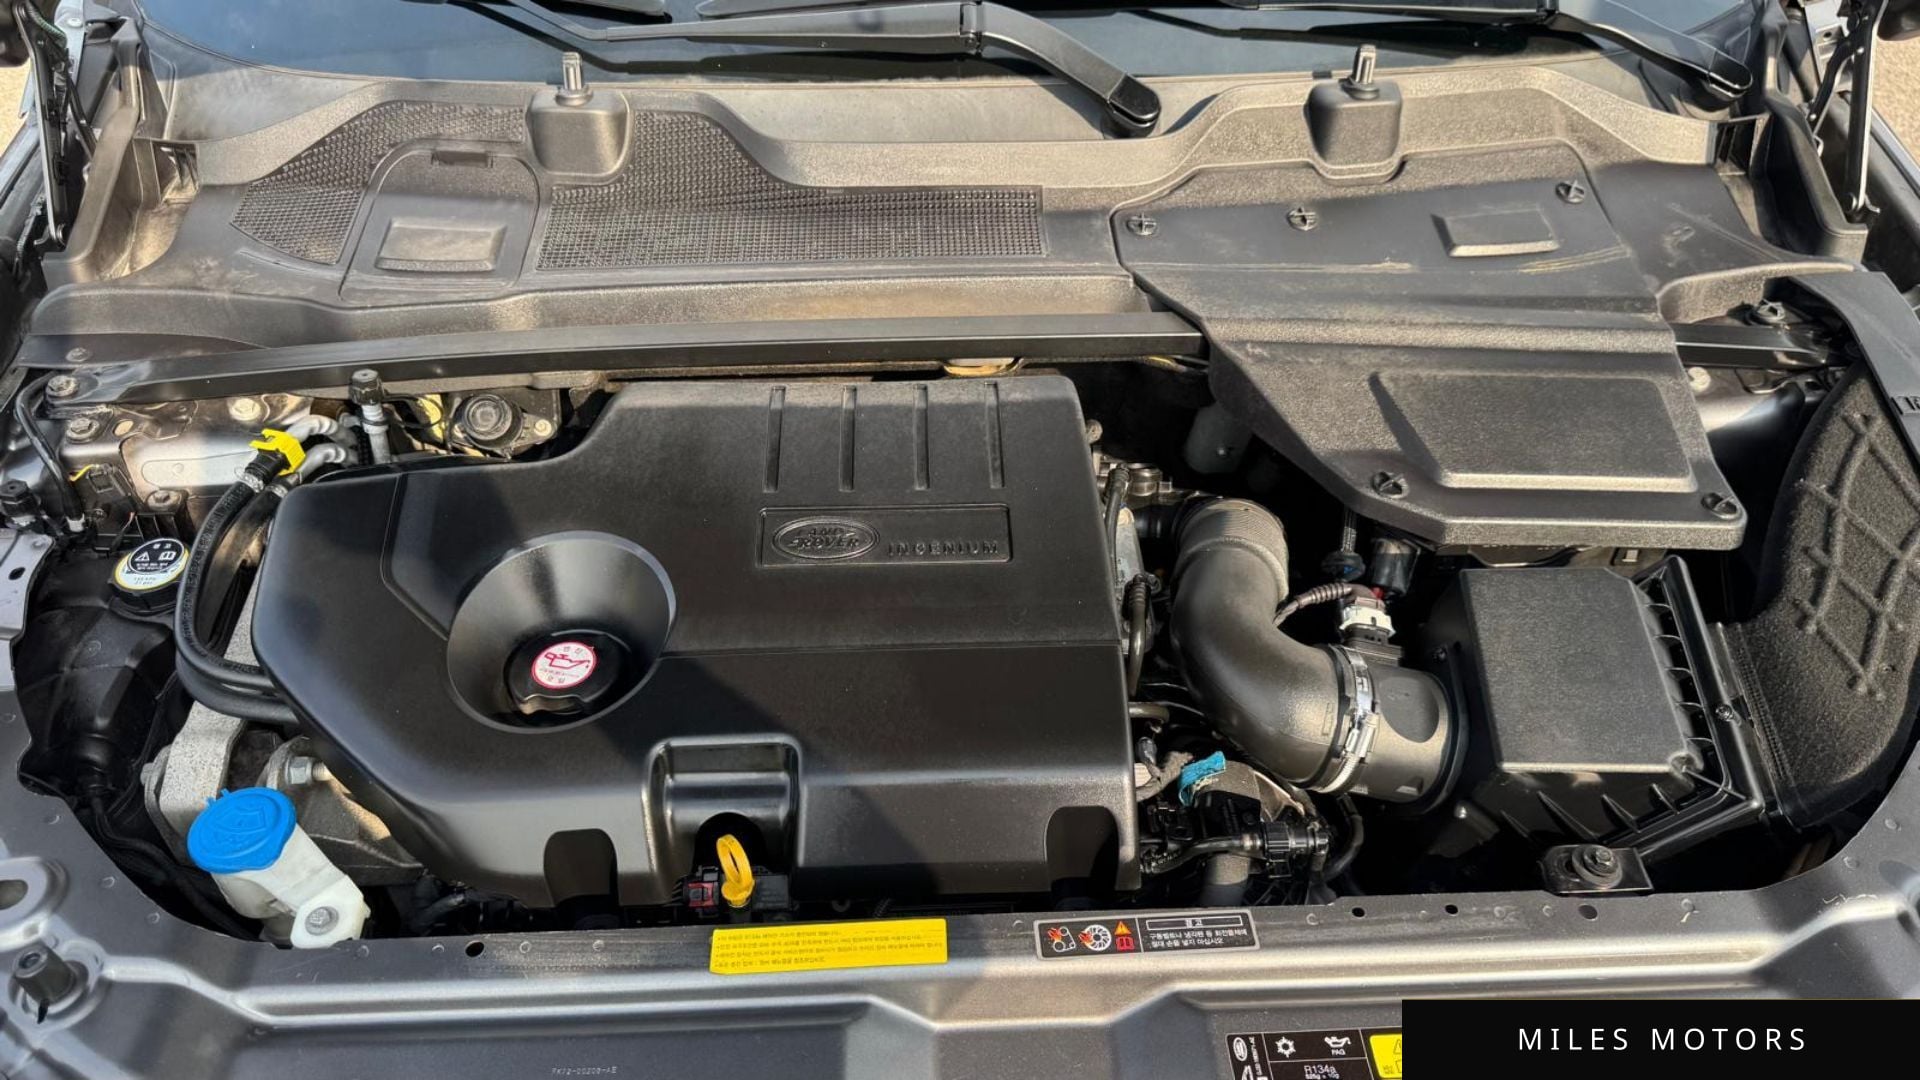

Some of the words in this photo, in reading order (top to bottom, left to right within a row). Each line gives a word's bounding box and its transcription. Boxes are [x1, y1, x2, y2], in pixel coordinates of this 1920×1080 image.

[797, 535, 859, 548] ROVER
[888, 540, 998, 556] INGENIUM
[1303, 1064, 1337, 1074] R134a
